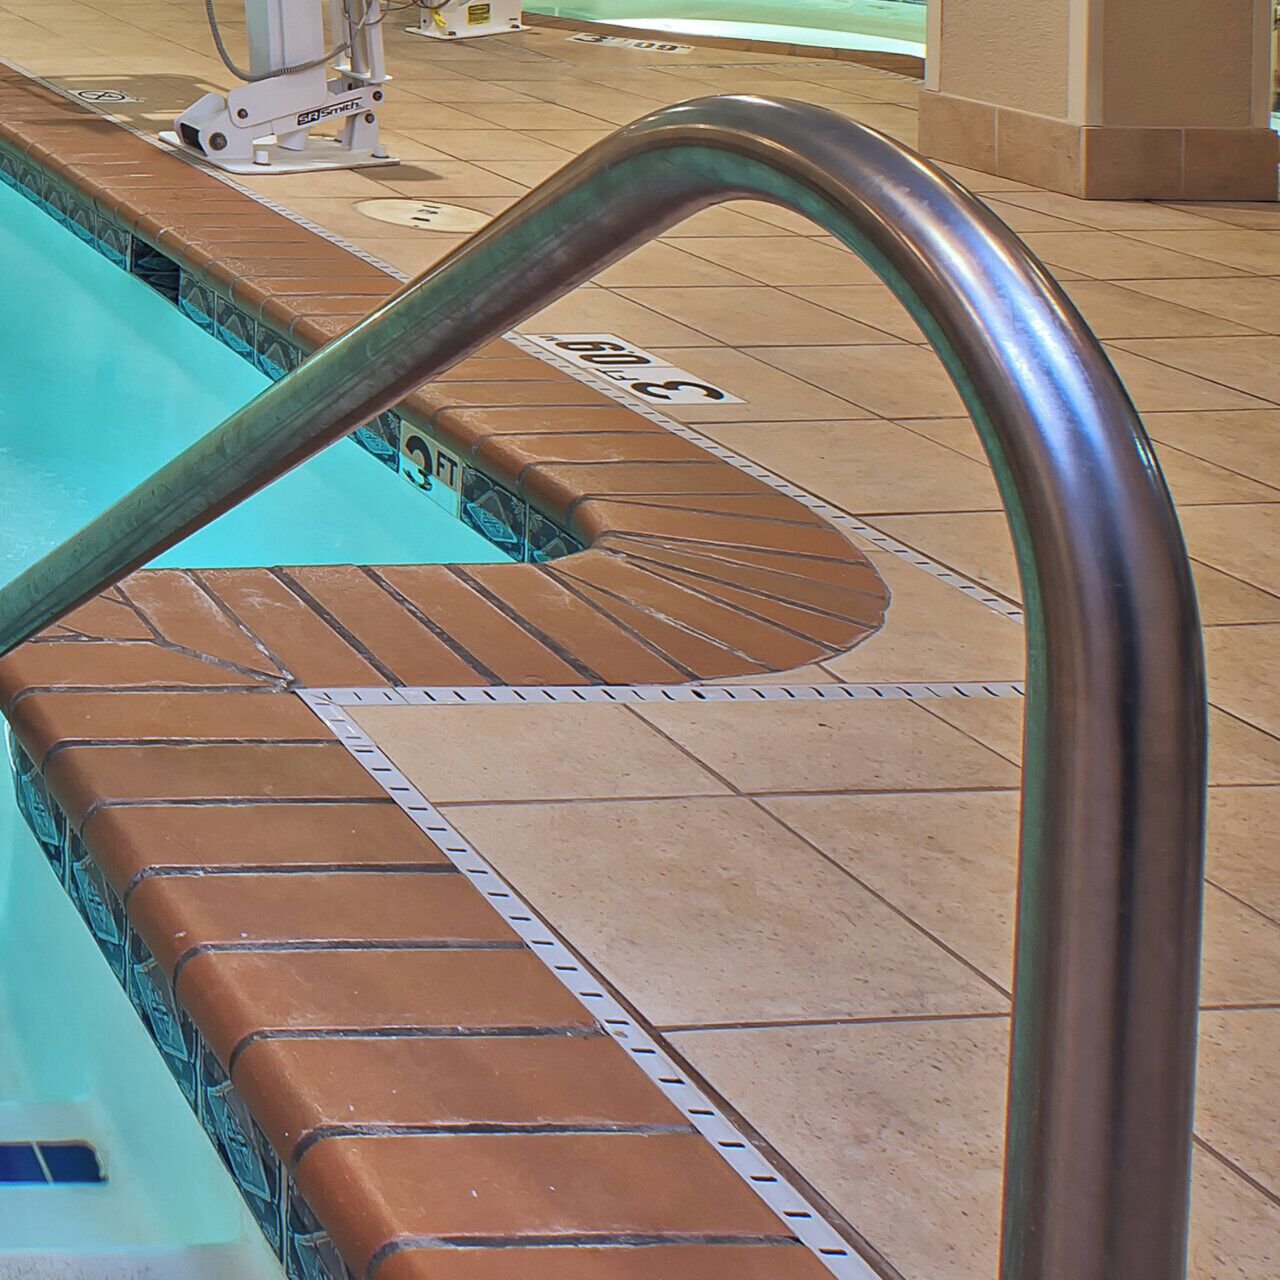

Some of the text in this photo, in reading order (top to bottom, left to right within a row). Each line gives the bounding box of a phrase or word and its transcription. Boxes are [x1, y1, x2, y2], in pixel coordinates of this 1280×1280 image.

[320, 101, 359, 118] Smith
[595, 368, 724, 400] 3 FT
[402, 434, 459, 492] 3 FT
